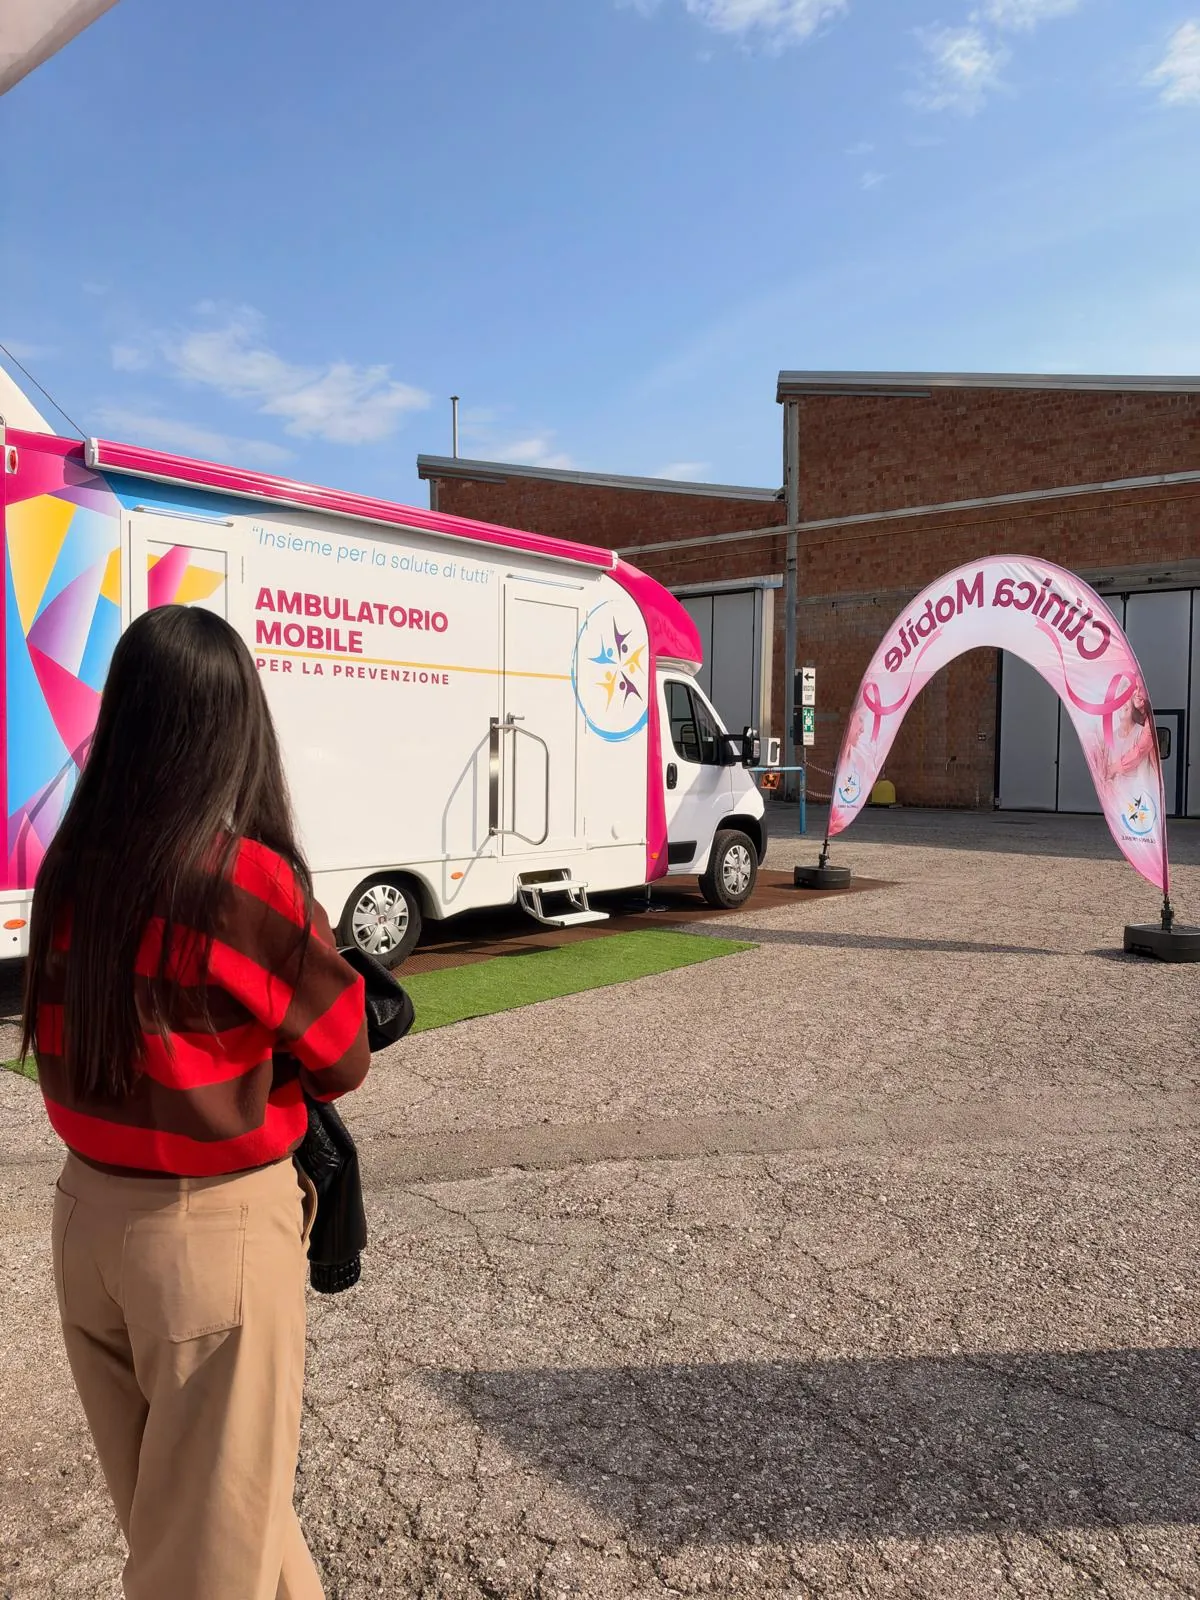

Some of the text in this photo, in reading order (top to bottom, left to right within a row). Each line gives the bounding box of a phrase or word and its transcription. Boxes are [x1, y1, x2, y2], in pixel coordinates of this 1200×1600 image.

[337, 544, 367, 563] per
[371, 548, 386, 566] la
[391, 554, 439, 576] salute
[442, 562, 457, 579] di
[255, 587, 449, 633] AMBULATORIO
[255, 619, 363, 654] MOBILE
[256, 658, 450, 685] PER LA PREVENZIONE
